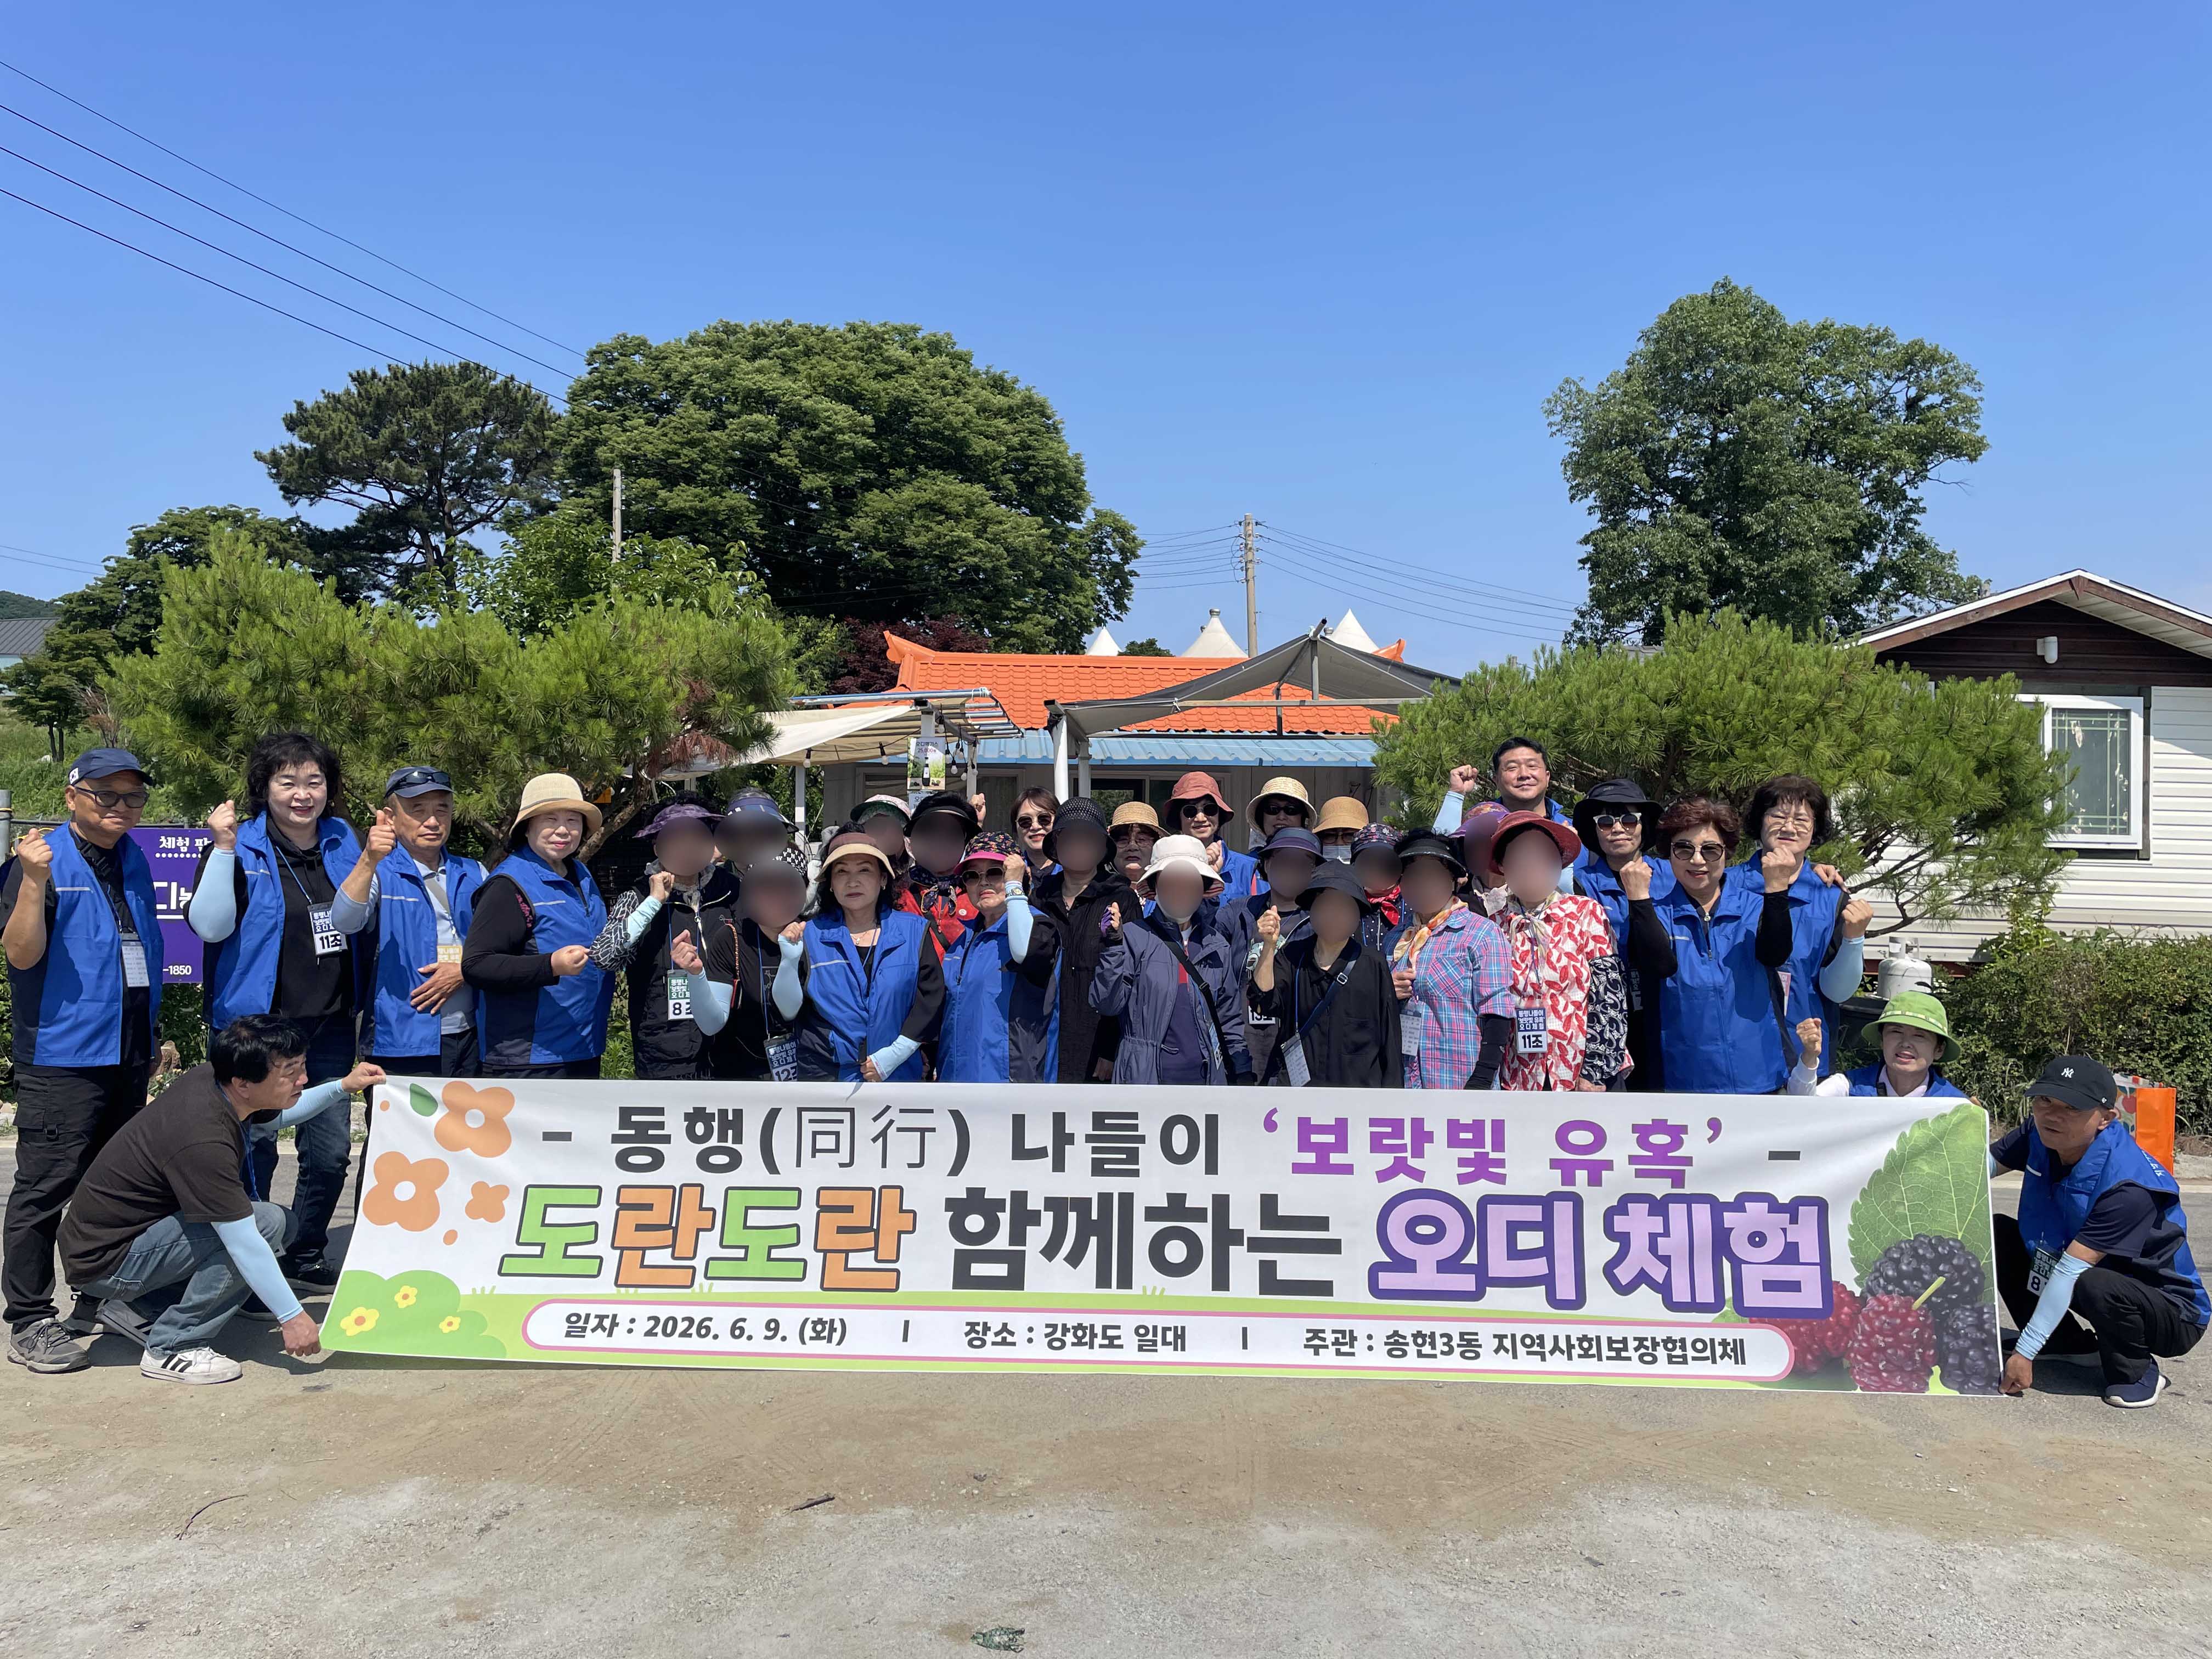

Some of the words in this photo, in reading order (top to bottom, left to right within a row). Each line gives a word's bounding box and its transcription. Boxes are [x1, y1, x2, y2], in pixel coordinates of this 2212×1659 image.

[159, 836, 189, 852] 체험
[319, 934, 342, 949] 11조
[1522, 1034, 1543, 1048] 11조
[611, 1105, 970, 1177] 동행(同行)
[1012, 1111, 1218, 1178] 나들이
[498, 1183, 917, 1293] 도란도란
[945, 1187, 1342, 1297] 함께하는
[1368, 1188, 1587, 1310] 오디
[1602, 1192, 1833, 1320] 체험
[799, 1317, 847, 1346] (화)
[1044, 1323, 1124, 1351] 강화도
[1134, 1324, 1186, 1352] 일대
[1384, 1330, 1482, 1361] 송현3동
[1493, 1333, 1746, 1365] 지역사회보장협의체
